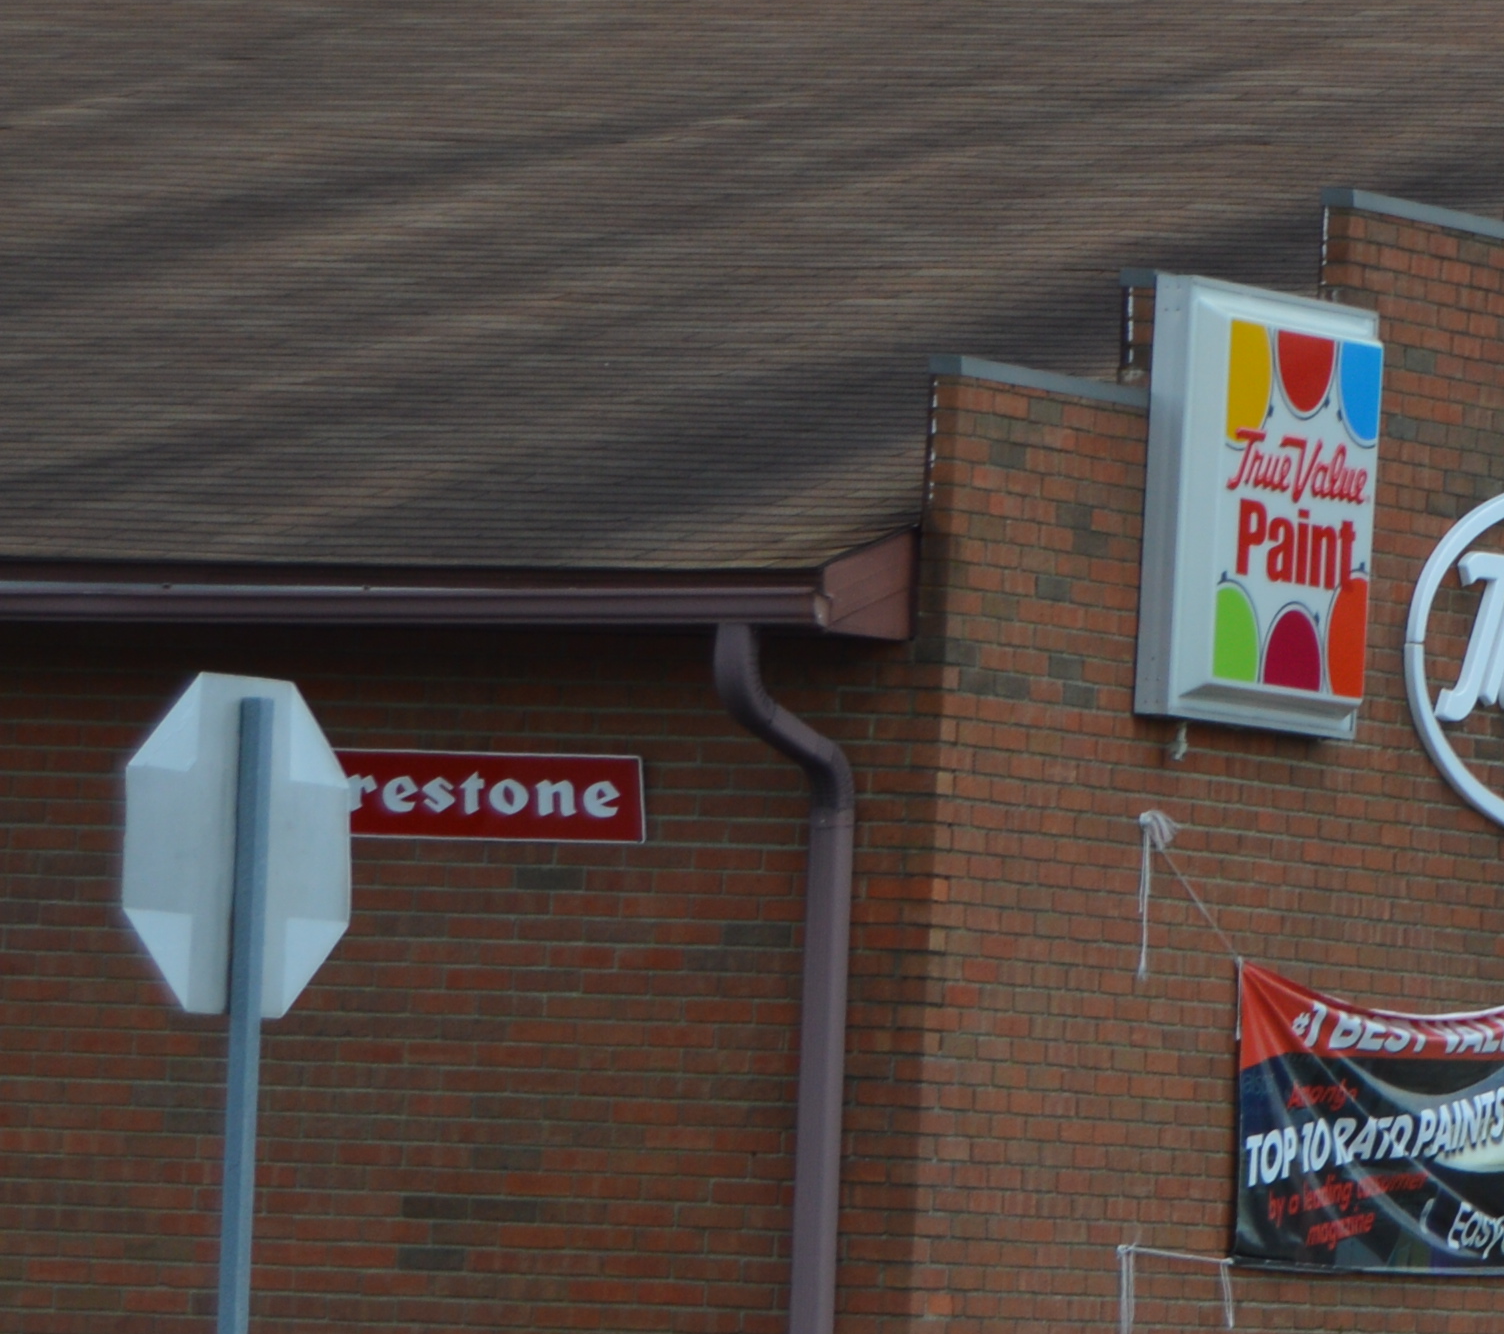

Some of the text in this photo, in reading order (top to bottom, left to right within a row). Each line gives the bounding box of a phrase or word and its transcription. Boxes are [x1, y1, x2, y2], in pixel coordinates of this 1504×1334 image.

[1226, 427, 1368, 505] True Value
[1235, 498, 1356, 593] Paint
[347, 771, 622, 819] restone
[1328, 1011, 1427, 1053] BEST
[1246, 1124, 1298, 1187] TOP
[1301, 1118, 1332, 1174] 10
